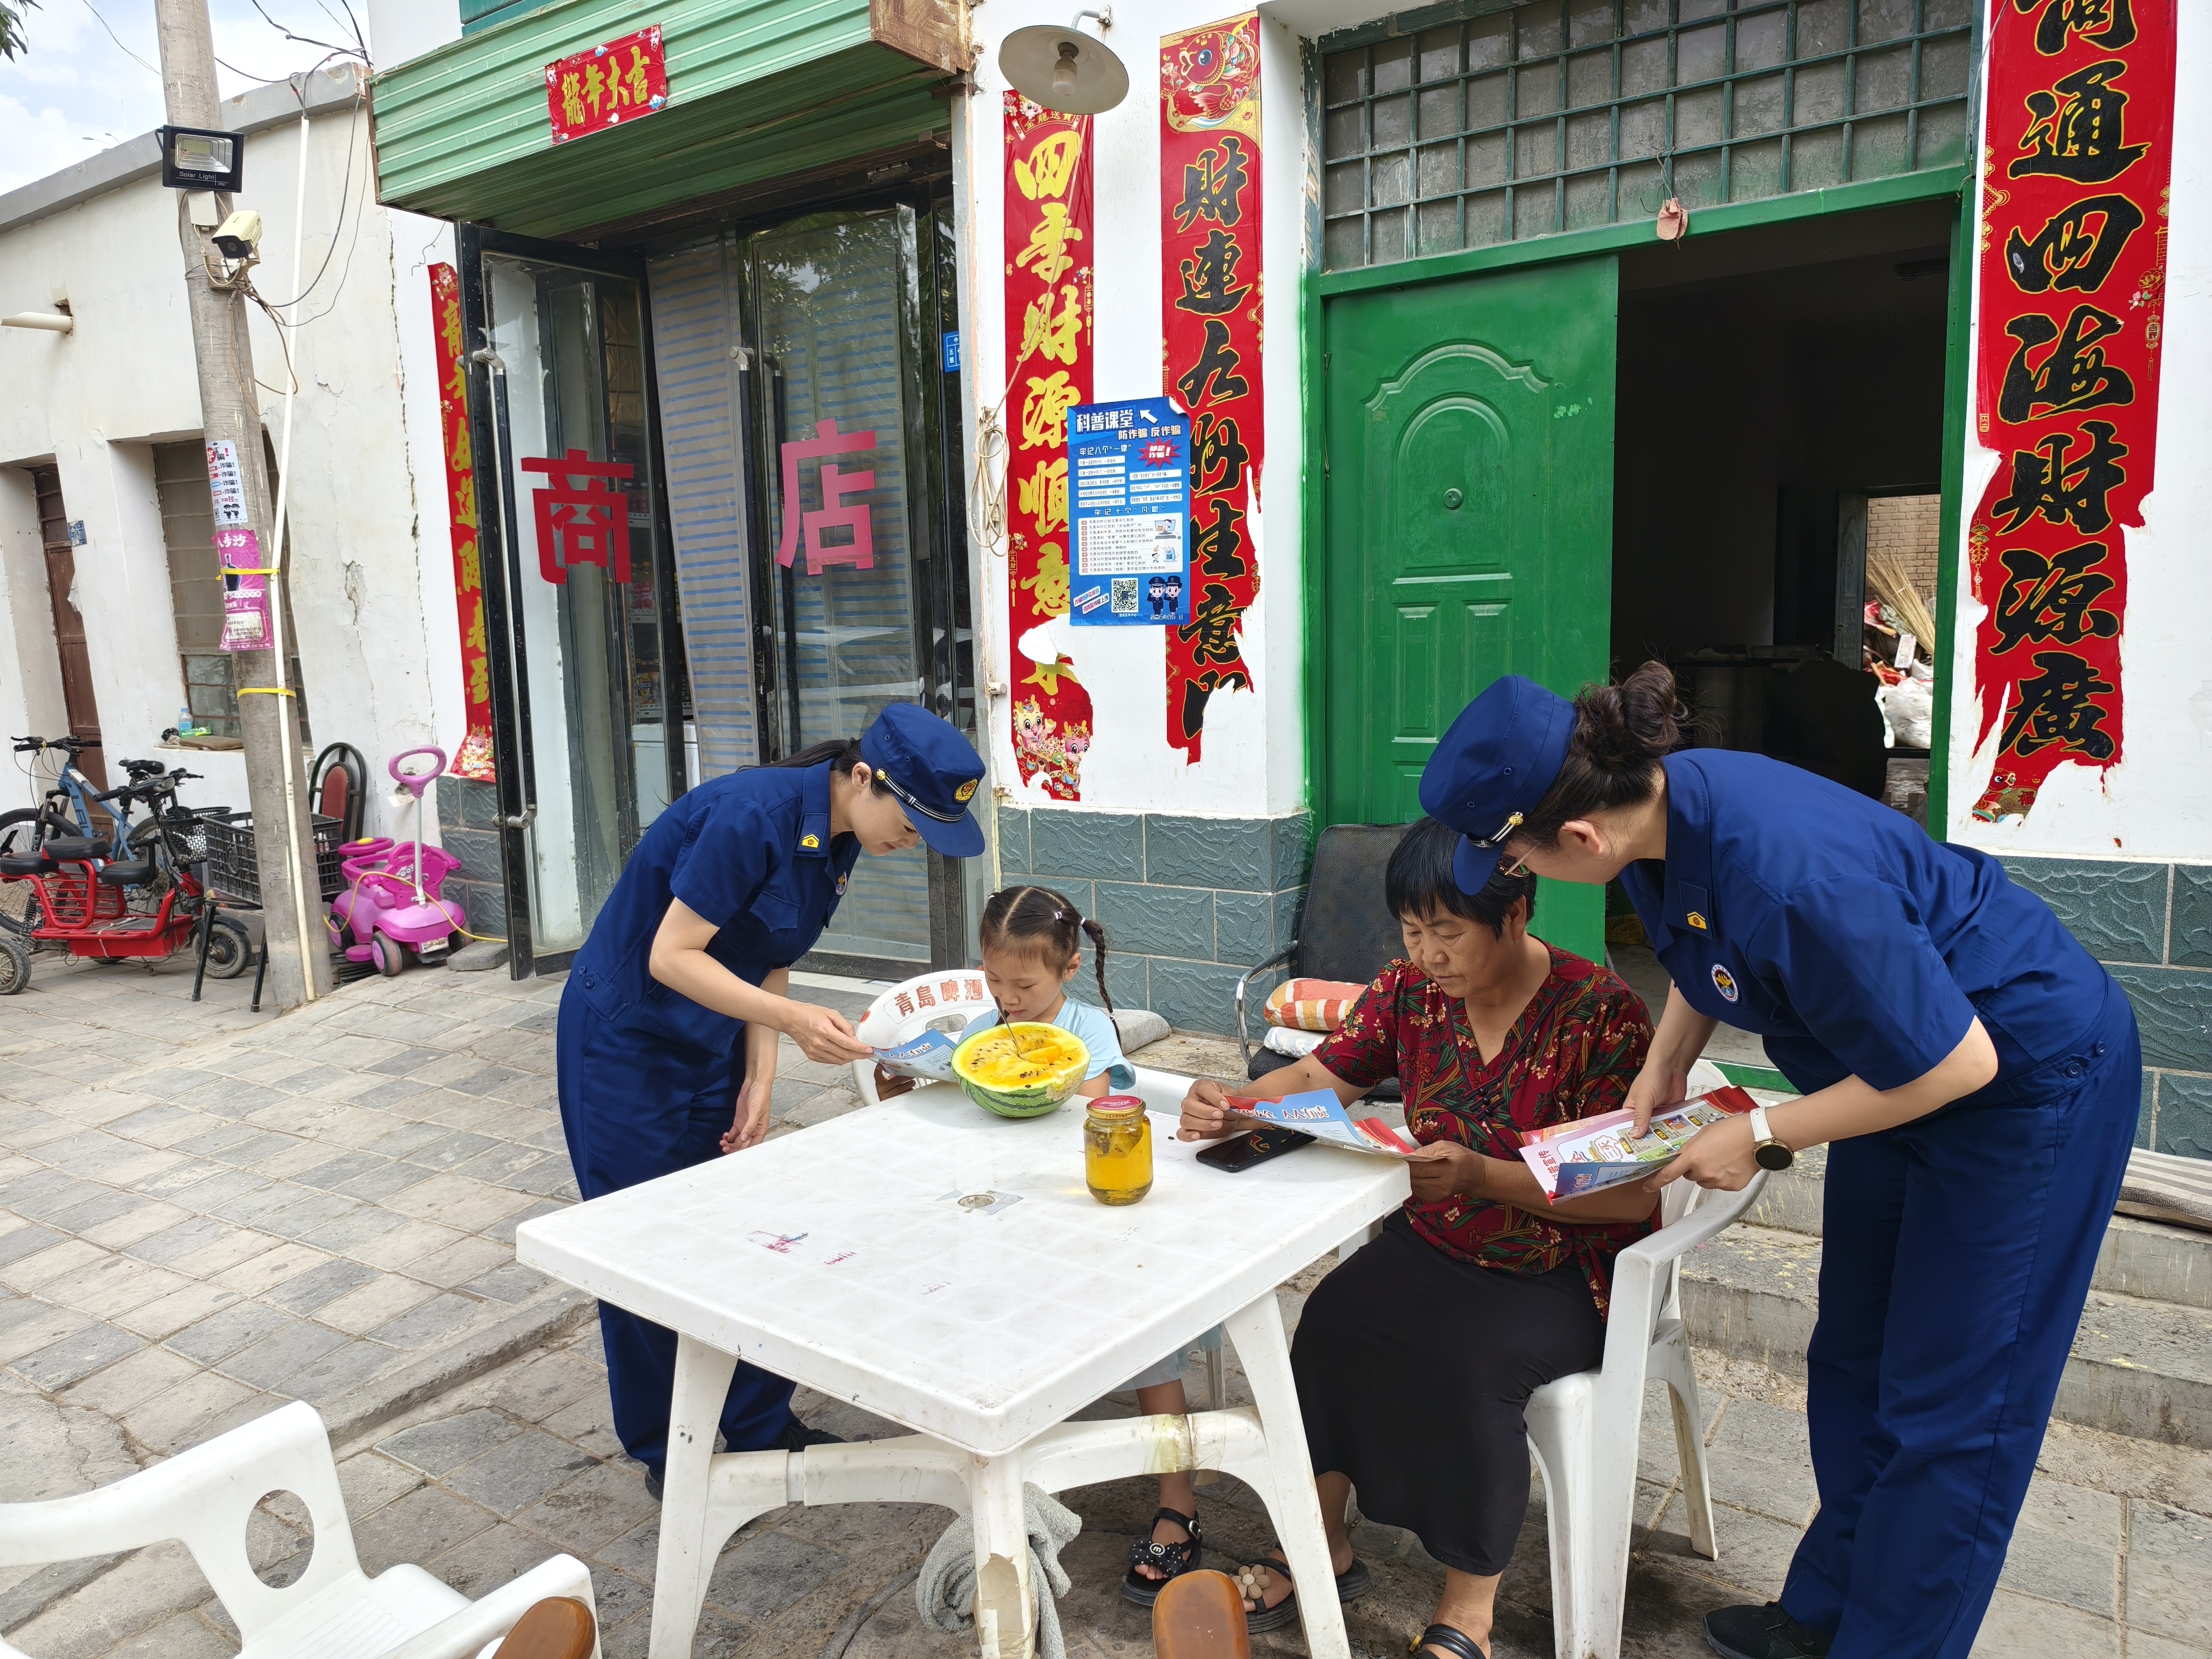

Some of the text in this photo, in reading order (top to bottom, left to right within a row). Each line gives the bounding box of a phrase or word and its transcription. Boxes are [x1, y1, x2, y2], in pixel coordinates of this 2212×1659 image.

[1077, 409, 1134, 433] 科普课堂
[1118, 424, 1181, 440] 防诈骗 反诈骗
[2018, 791, 2035, 806] 福
[1282, 1105, 1330, 1120] 人人有责
